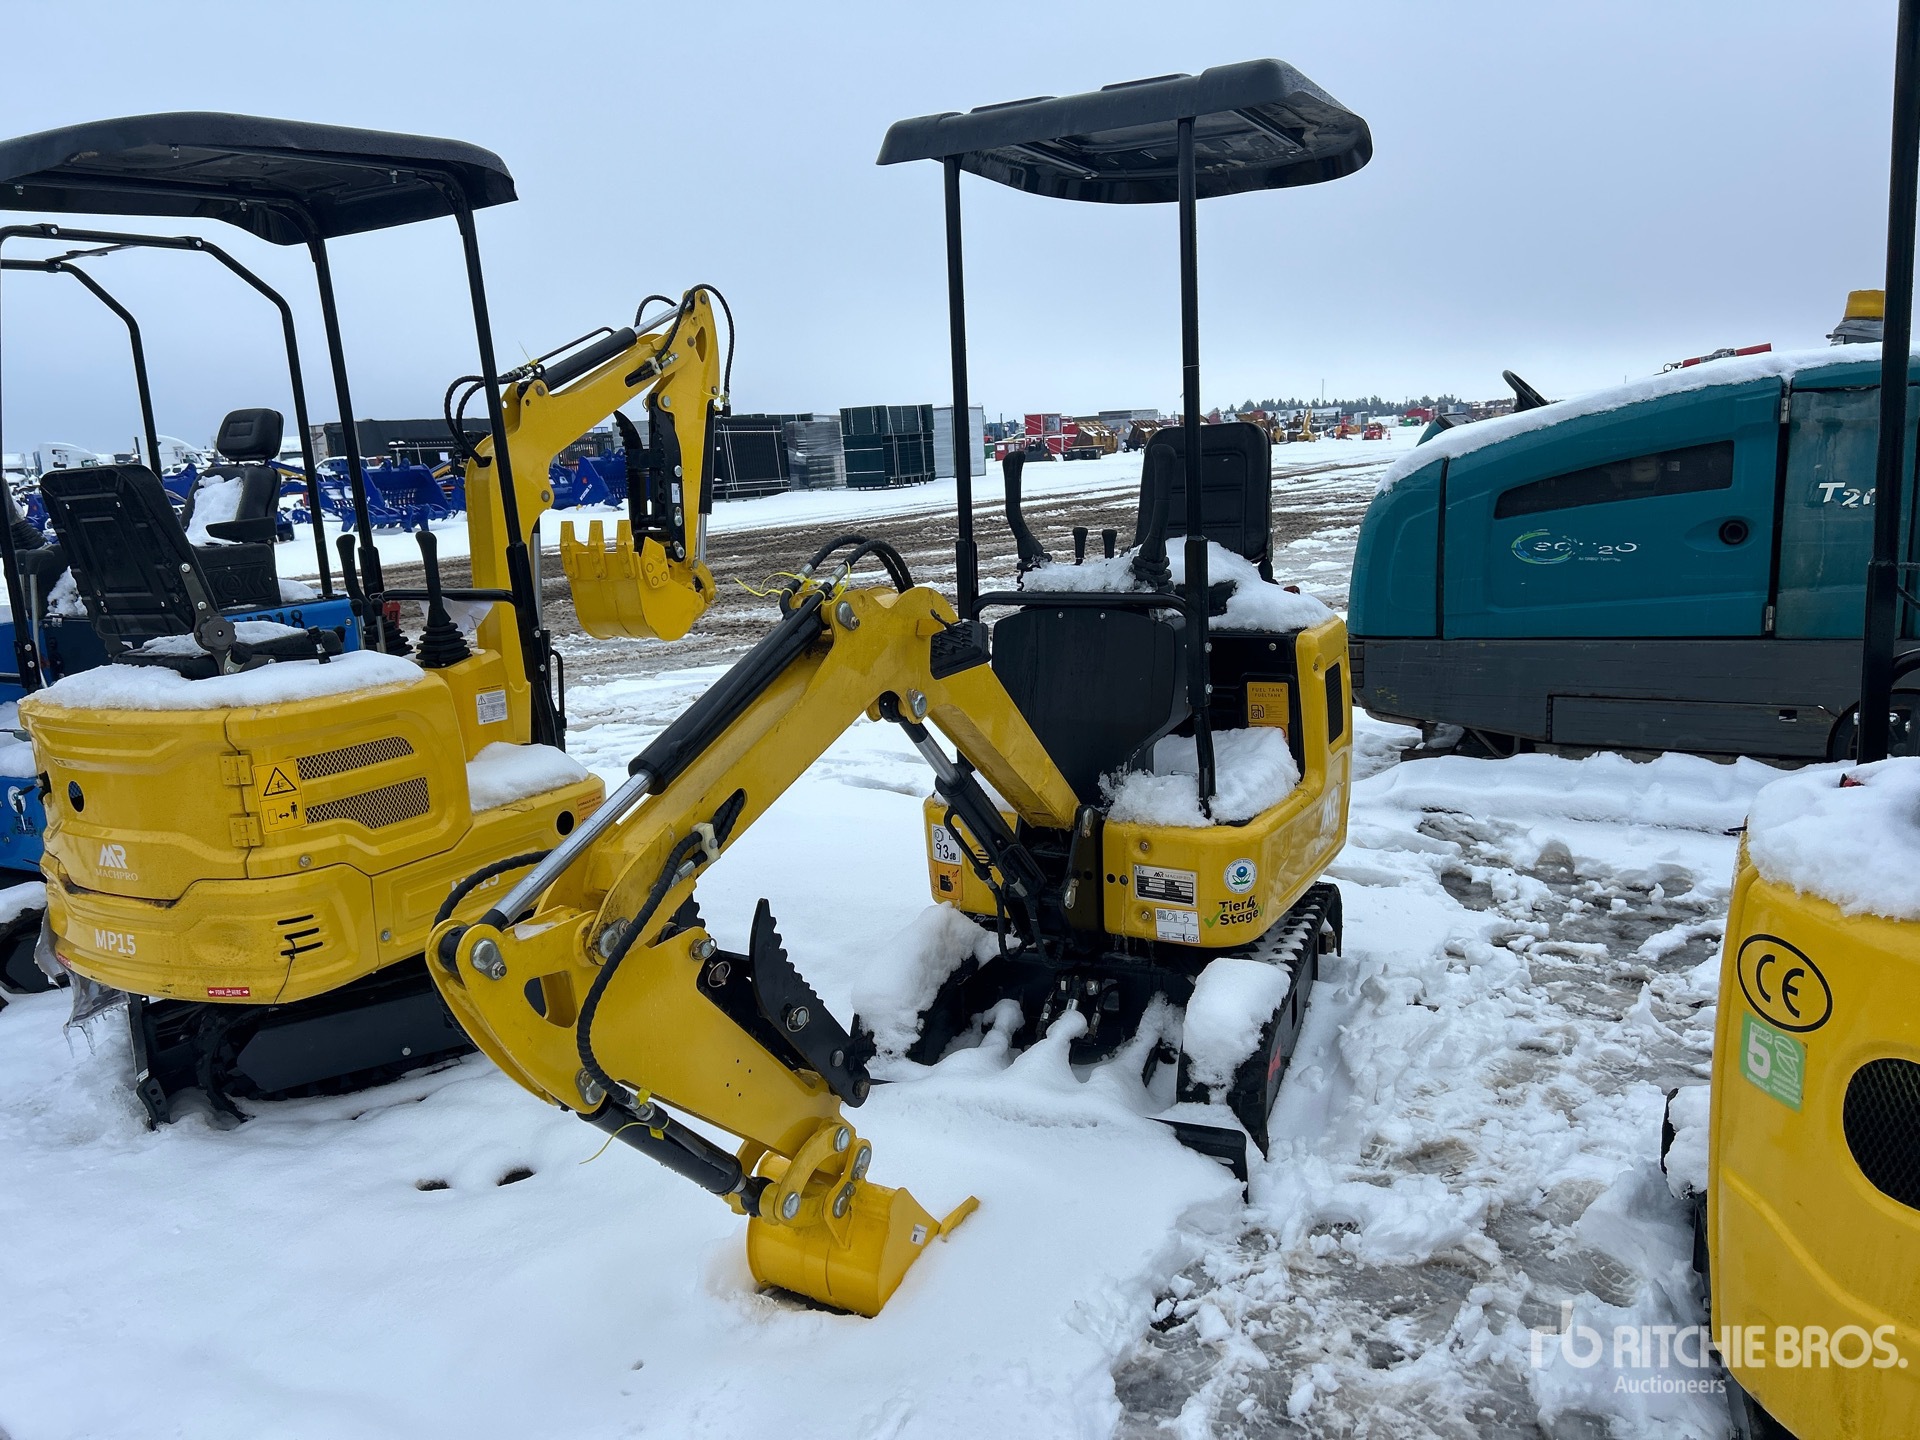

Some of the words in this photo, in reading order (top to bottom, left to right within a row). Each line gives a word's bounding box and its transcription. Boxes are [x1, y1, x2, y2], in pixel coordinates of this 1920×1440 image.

[95, 868, 139, 881] MACHPRO
[1219, 908, 1259, 925] Stage
[94, 928, 136, 955] MP15
[1756, 953, 1805, 1019] CE
